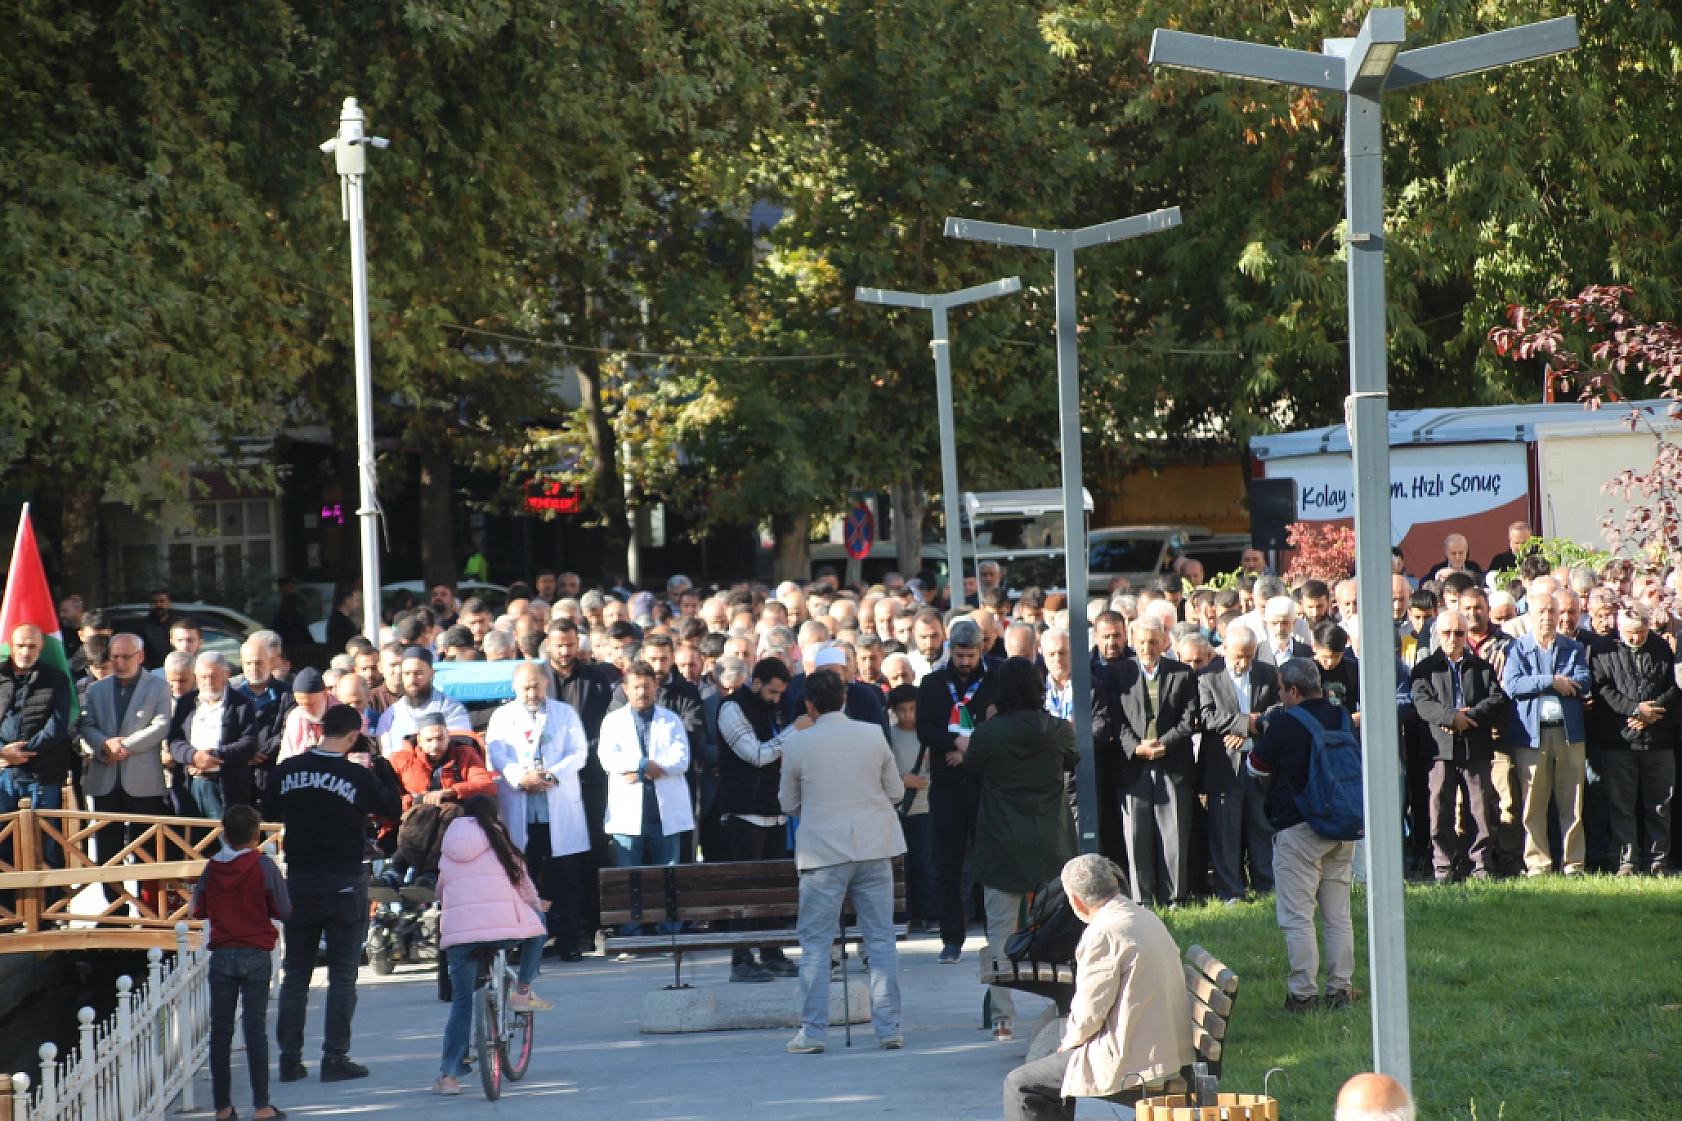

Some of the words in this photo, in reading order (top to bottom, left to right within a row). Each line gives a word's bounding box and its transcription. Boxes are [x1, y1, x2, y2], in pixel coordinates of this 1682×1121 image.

[1302, 484, 1347, 512] Kolay
[1411, 474, 1444, 499] Hızlı
[1450, 473, 1502, 496] Sonuç
